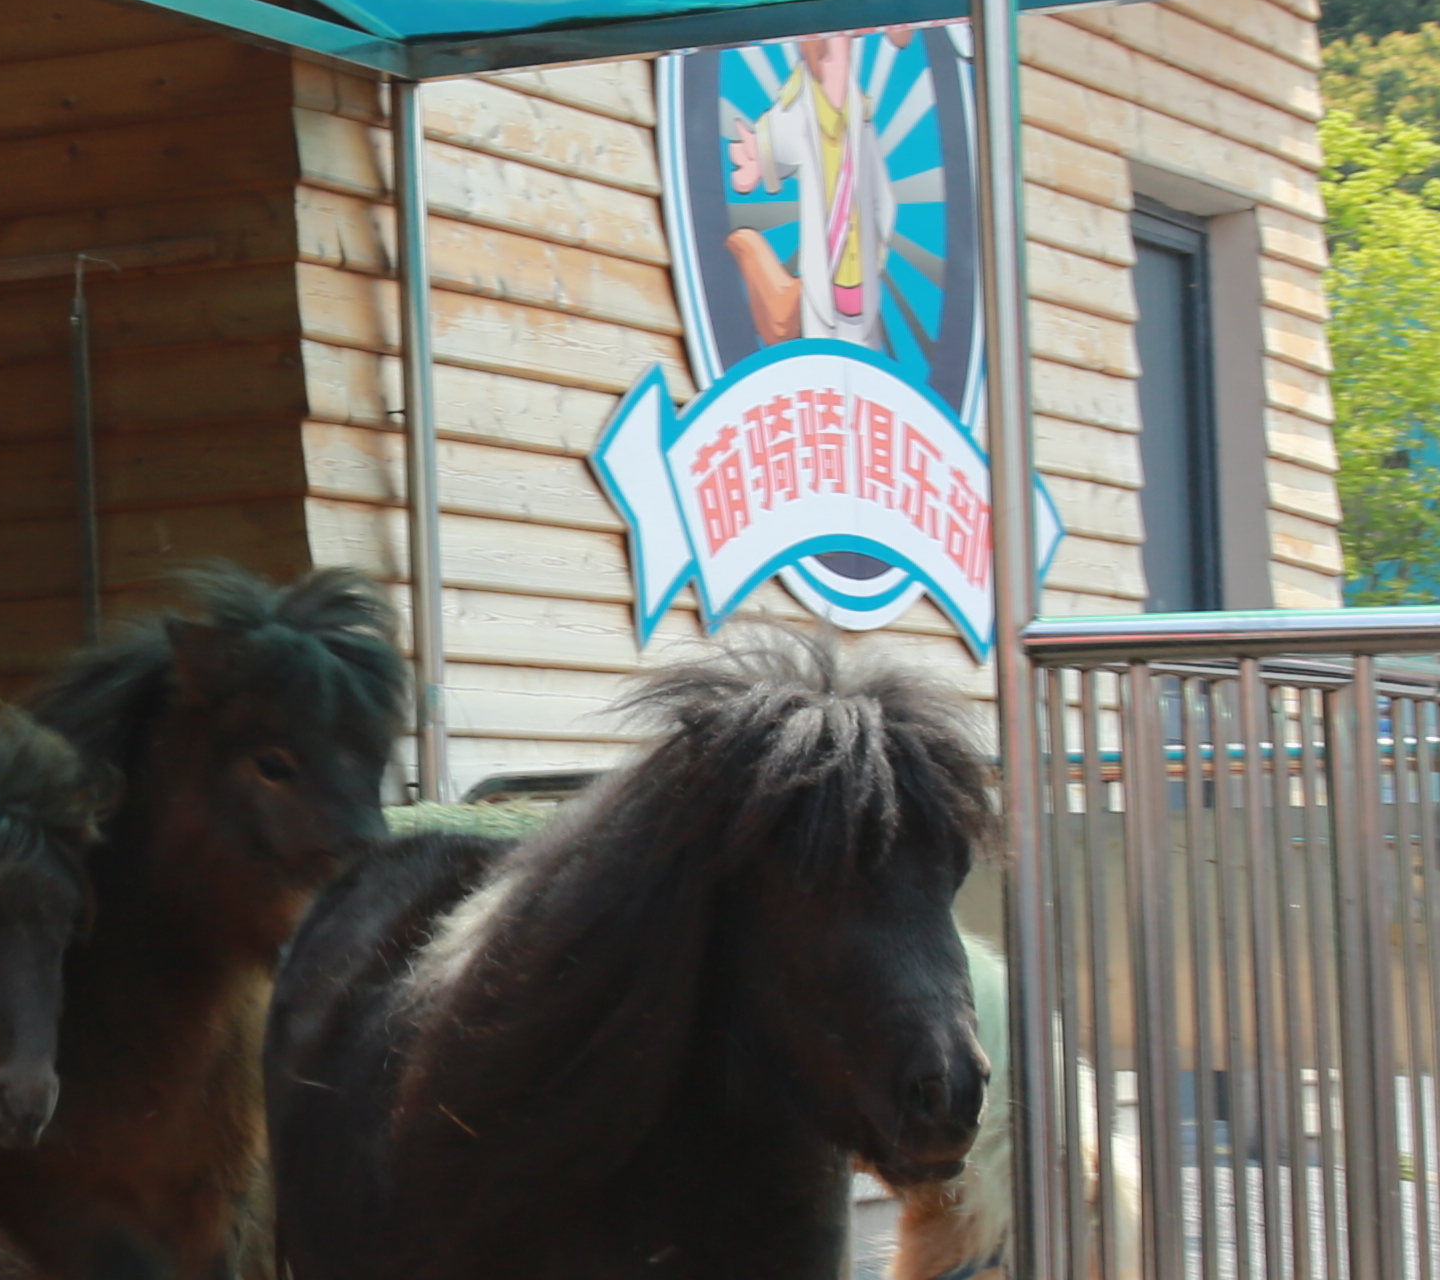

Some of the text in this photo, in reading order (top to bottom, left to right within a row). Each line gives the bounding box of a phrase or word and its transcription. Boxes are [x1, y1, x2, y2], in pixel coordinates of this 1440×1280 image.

[690, 388, 993, 589] 萌骑骑俱乐部
